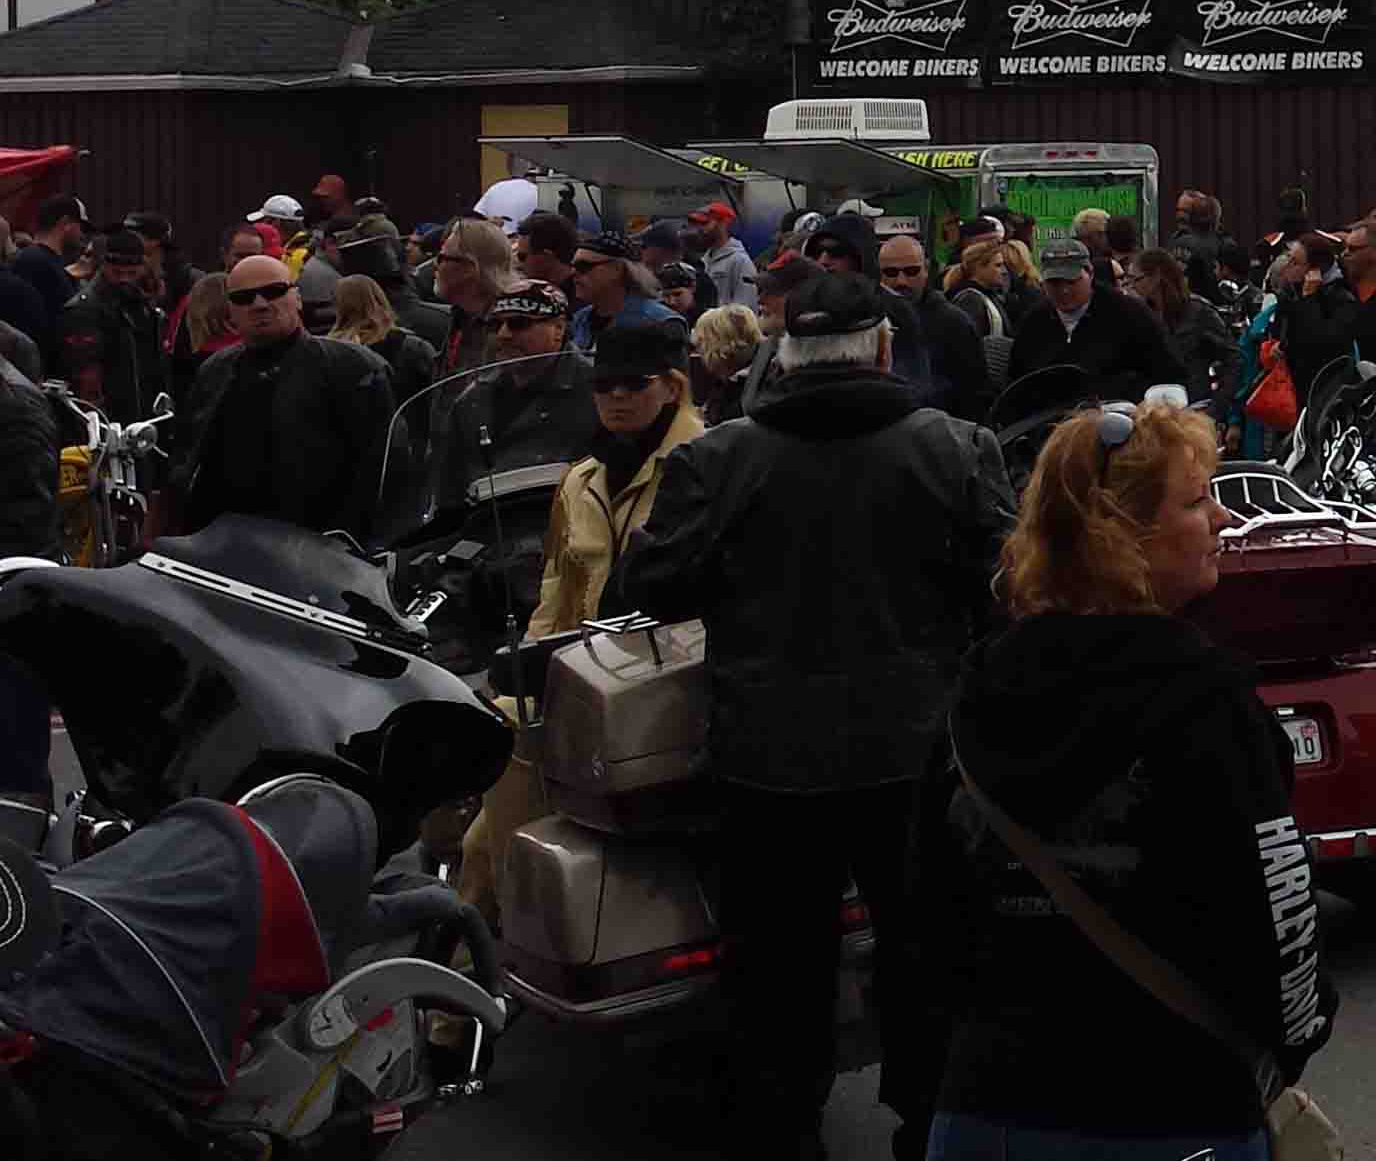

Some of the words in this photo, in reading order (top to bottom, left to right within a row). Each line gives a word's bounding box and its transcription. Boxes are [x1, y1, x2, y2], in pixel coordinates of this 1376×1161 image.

[826, 3, 966, 37] Budweiser
[1008, 0, 1152, 33] Budweiser
[819, 58, 910, 79] WELCOME
[912, 56, 979, 78] BIKERS
[999, 55, 1094, 75] WELCOME
[1097, 54, 1167, 73] BIKERS
[1184, 52, 1286, 72] WELCOME
[1289, 50, 1364, 70] BIKERS
[931, 150, 978, 169] HERE
